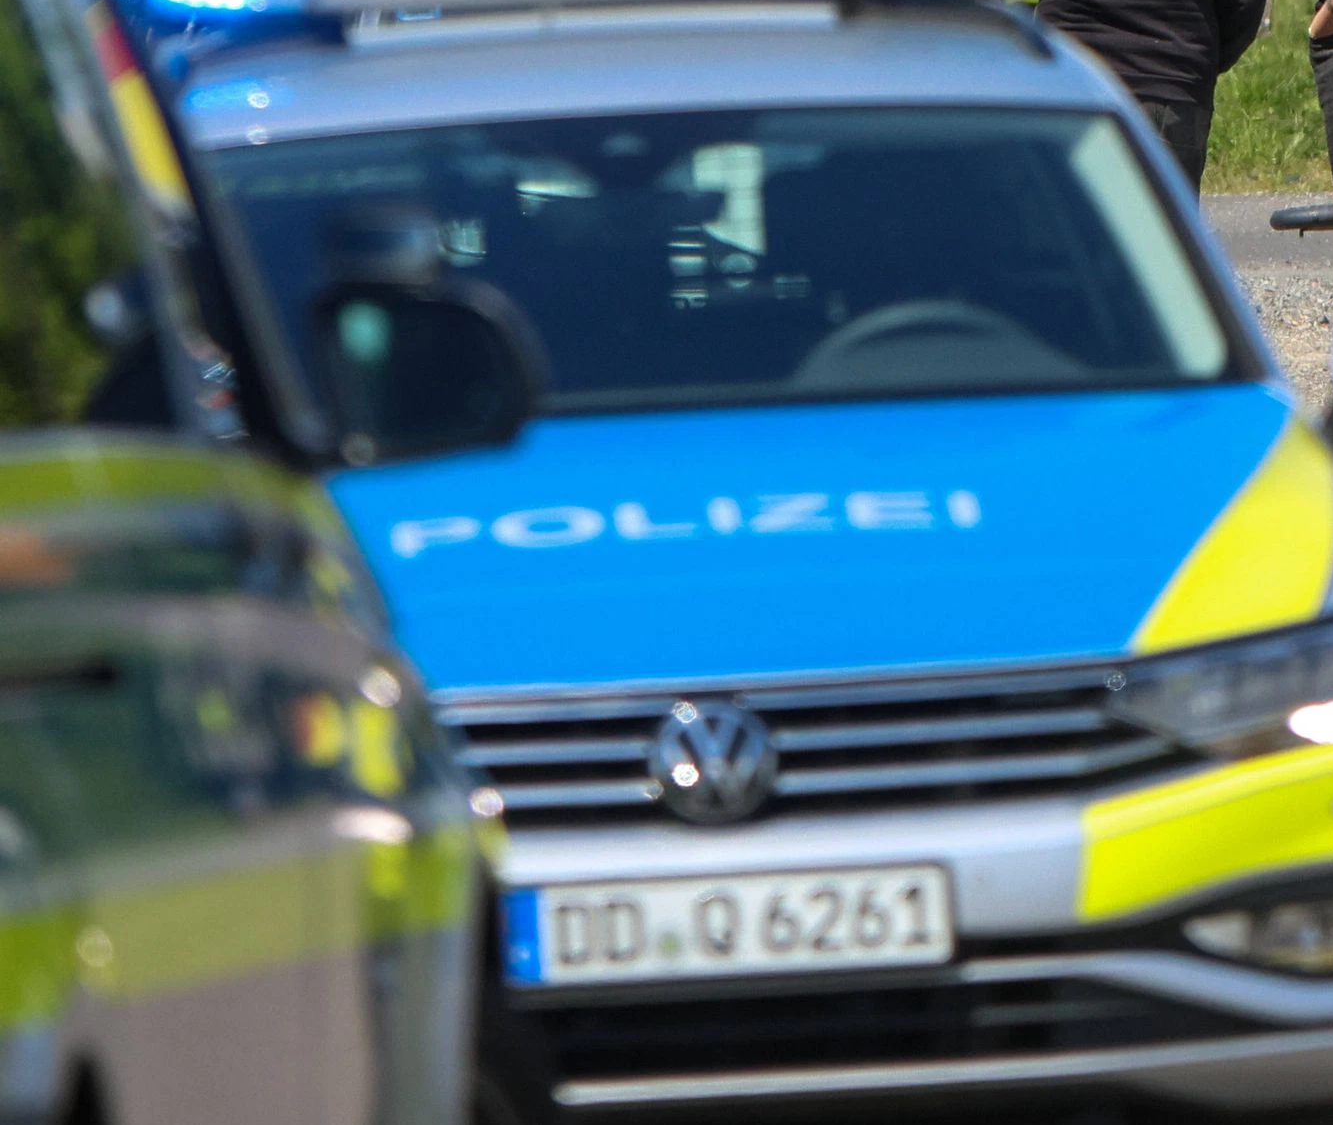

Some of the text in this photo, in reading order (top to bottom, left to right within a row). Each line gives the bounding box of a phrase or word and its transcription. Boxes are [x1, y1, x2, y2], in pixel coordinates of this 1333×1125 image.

[389, 488, 982, 559] POLIZEI
[556, 882, 932, 967] DD Q 6261
